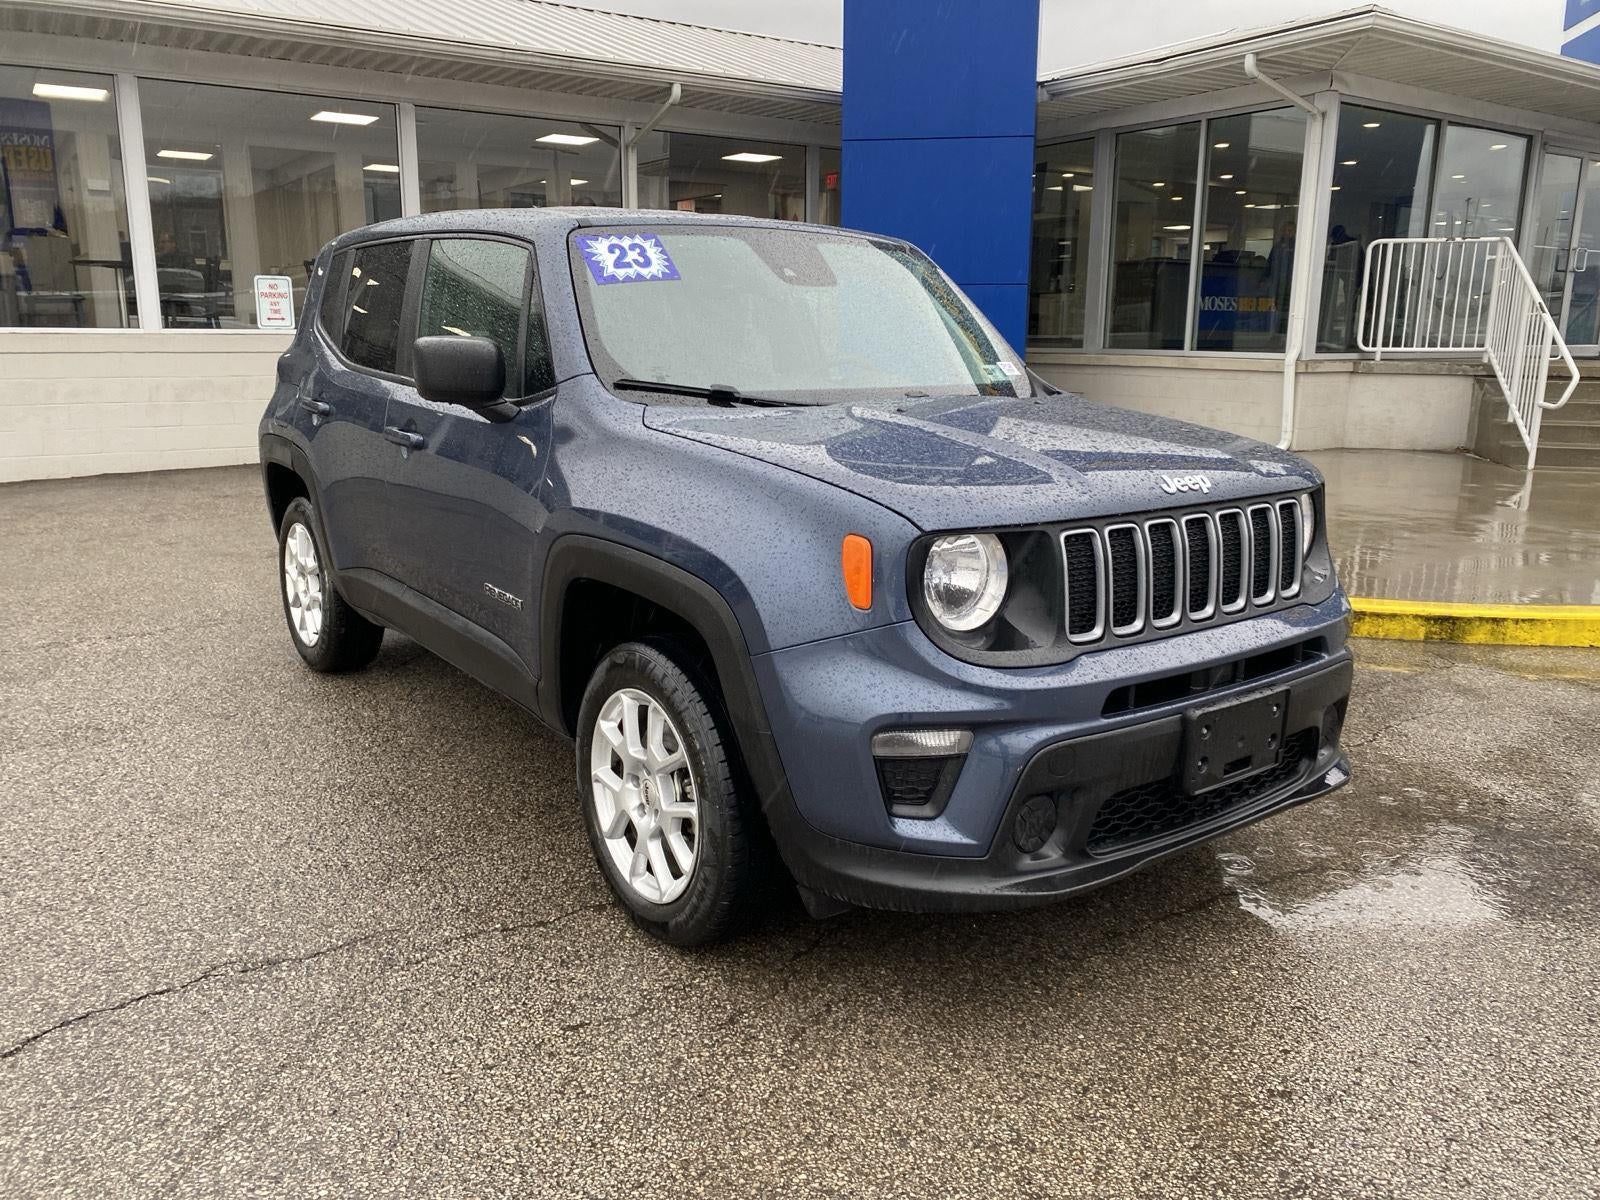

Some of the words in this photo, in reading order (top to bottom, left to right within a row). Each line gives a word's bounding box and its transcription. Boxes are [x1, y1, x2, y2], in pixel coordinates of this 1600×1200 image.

[607, 242, 653, 270] 23
[260, 292, 289, 300] PARKING
[1199, 296, 1238, 312] MOSES
[1160, 474, 1212, 495] Jeep
